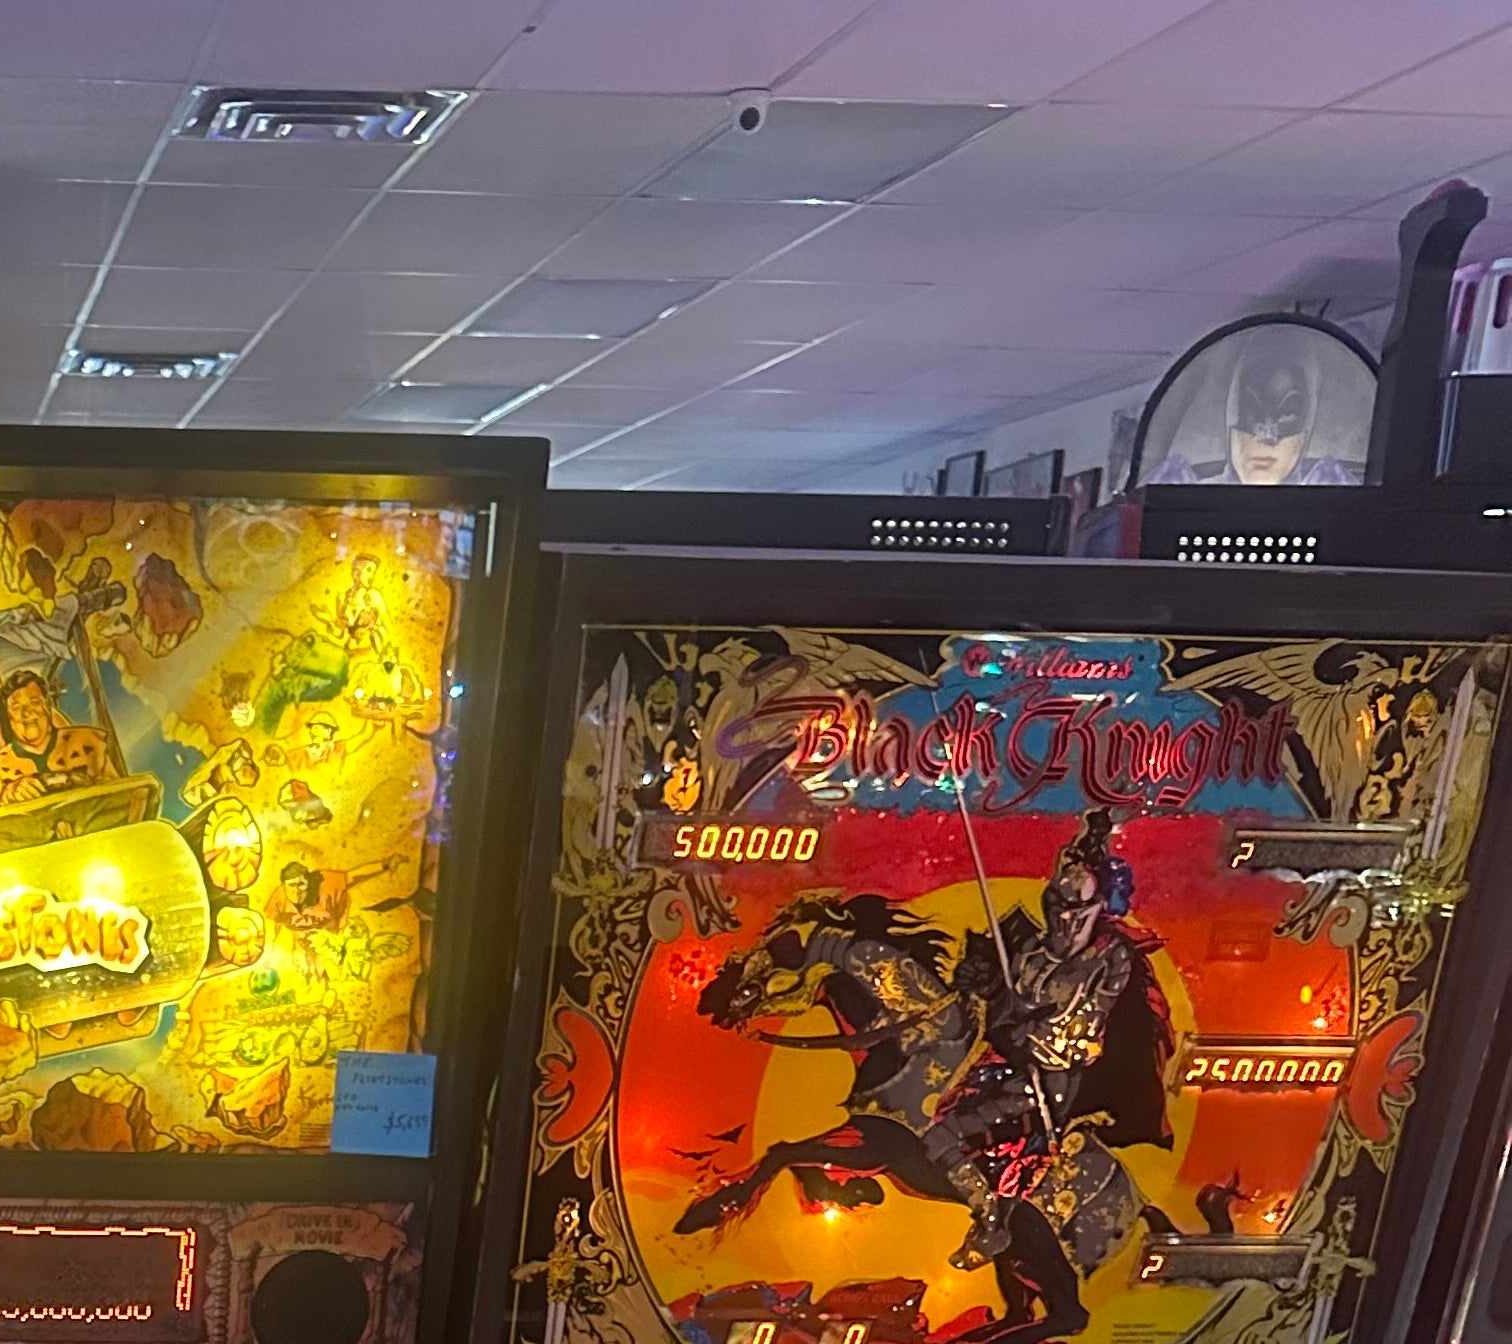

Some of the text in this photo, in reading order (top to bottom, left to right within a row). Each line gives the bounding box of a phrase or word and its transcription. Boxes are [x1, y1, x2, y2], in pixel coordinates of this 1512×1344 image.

[728, 685, 1296, 808] Black Knight
[673, 825, 819, 862] 500,000
